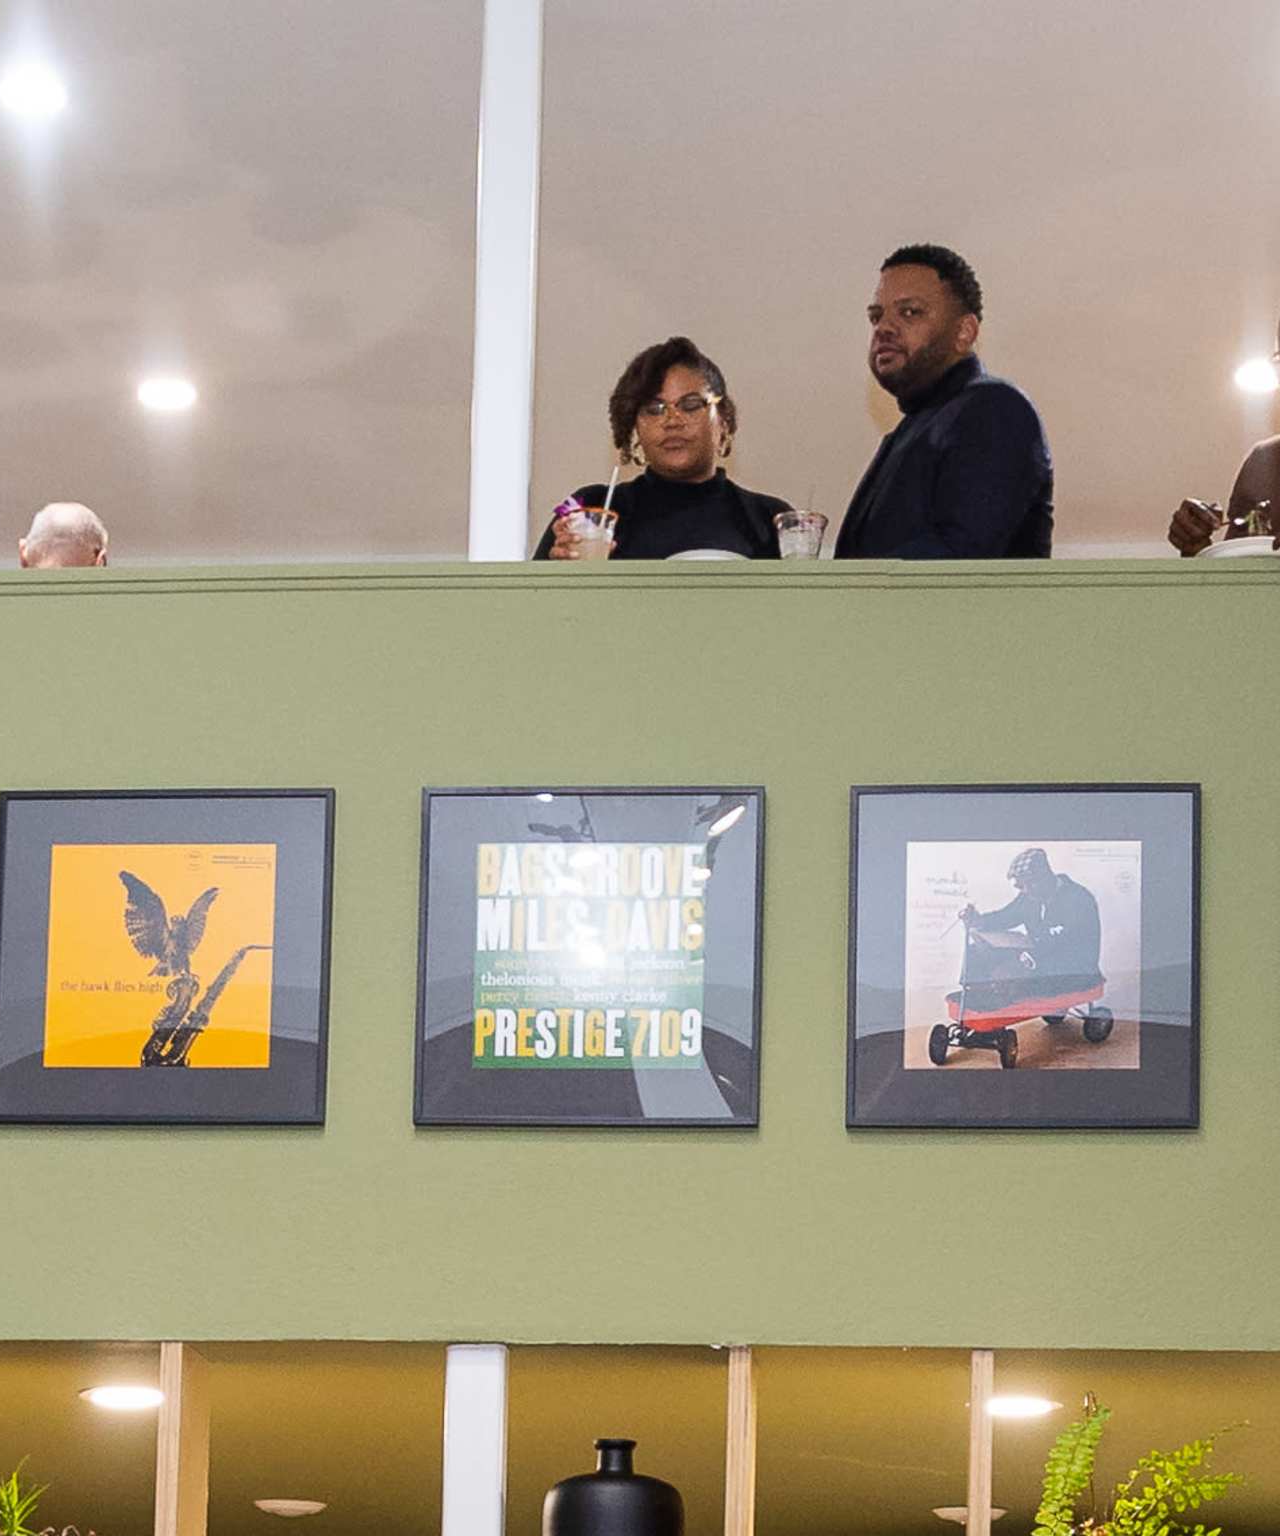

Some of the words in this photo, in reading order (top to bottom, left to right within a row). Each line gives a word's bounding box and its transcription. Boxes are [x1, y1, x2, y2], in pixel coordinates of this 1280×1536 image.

[60, 982, 78, 992] the
[80, 982, 109, 992] hawk
[139, 982, 163, 994] high
[474, 1008, 626, 1059] PRESTIGE
[629, 1007, 703, 1058] 7109
